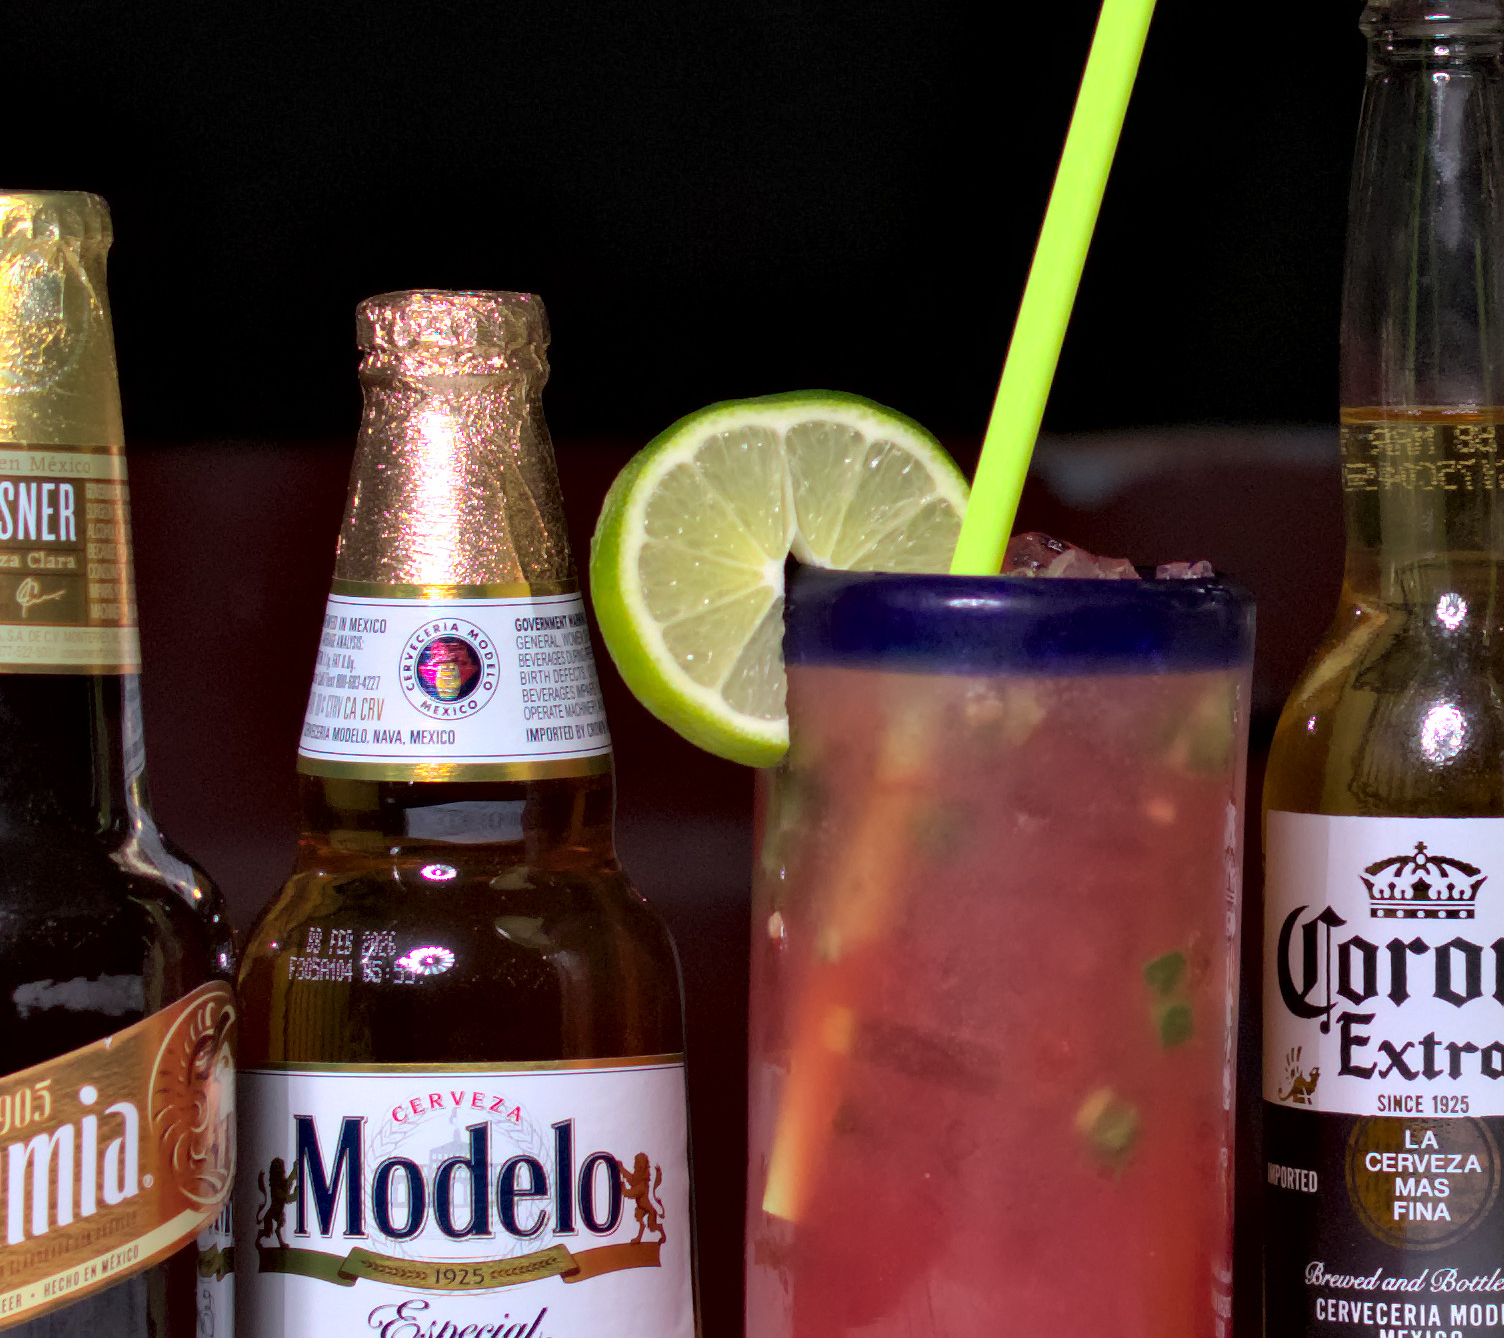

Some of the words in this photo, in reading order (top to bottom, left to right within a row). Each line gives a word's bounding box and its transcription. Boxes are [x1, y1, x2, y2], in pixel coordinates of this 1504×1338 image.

[29, 455, 91, 474] México
[27, 551, 77, 569] Clara
[349, 617, 387, 633] MEXICO
[514, 614, 567, 633] GOVERNMENT
[403, 622, 460, 692] CERVECERIA
[466, 628, 495, 693] MODELO
[518, 650, 566, 668] BEVERAGES
[519, 669, 551, 685] BIRTH
[522, 685, 576, 703] BEVERAGES
[360, 697, 385, 721] CRV
[420, 698, 479, 717] MEXICO
[523, 704, 565, 721] OPERATE
[372, 729, 406, 746] NAVA,
[410, 729, 455, 745] MEXICO
[525, 725, 575, 744] IMPORTED
[391, 1090, 524, 1124] CERVEZA
[1377, 1094, 1424, 1113] SINCE
[1431, 1095, 1470, 1114] 1925
[1404, 1129, 1439, 1149] LA
[1365, 1152, 1482, 1173] CERVEZA
[293, 1113, 625, 1242] Modelo
[1395, 1177, 1450, 1198] MAS
[1393, 1201, 1452, 1222] FINA
[43, 1271, 80, 1299] HECHO
[83, 1264, 97, 1282] EN
[433, 1266, 486, 1285] 1925
[1304, 1260, 1382, 1292] Brewed
[1381, 1268, 1430, 1293] and
[1315, 1298, 1442, 1327] CERVECERIA
